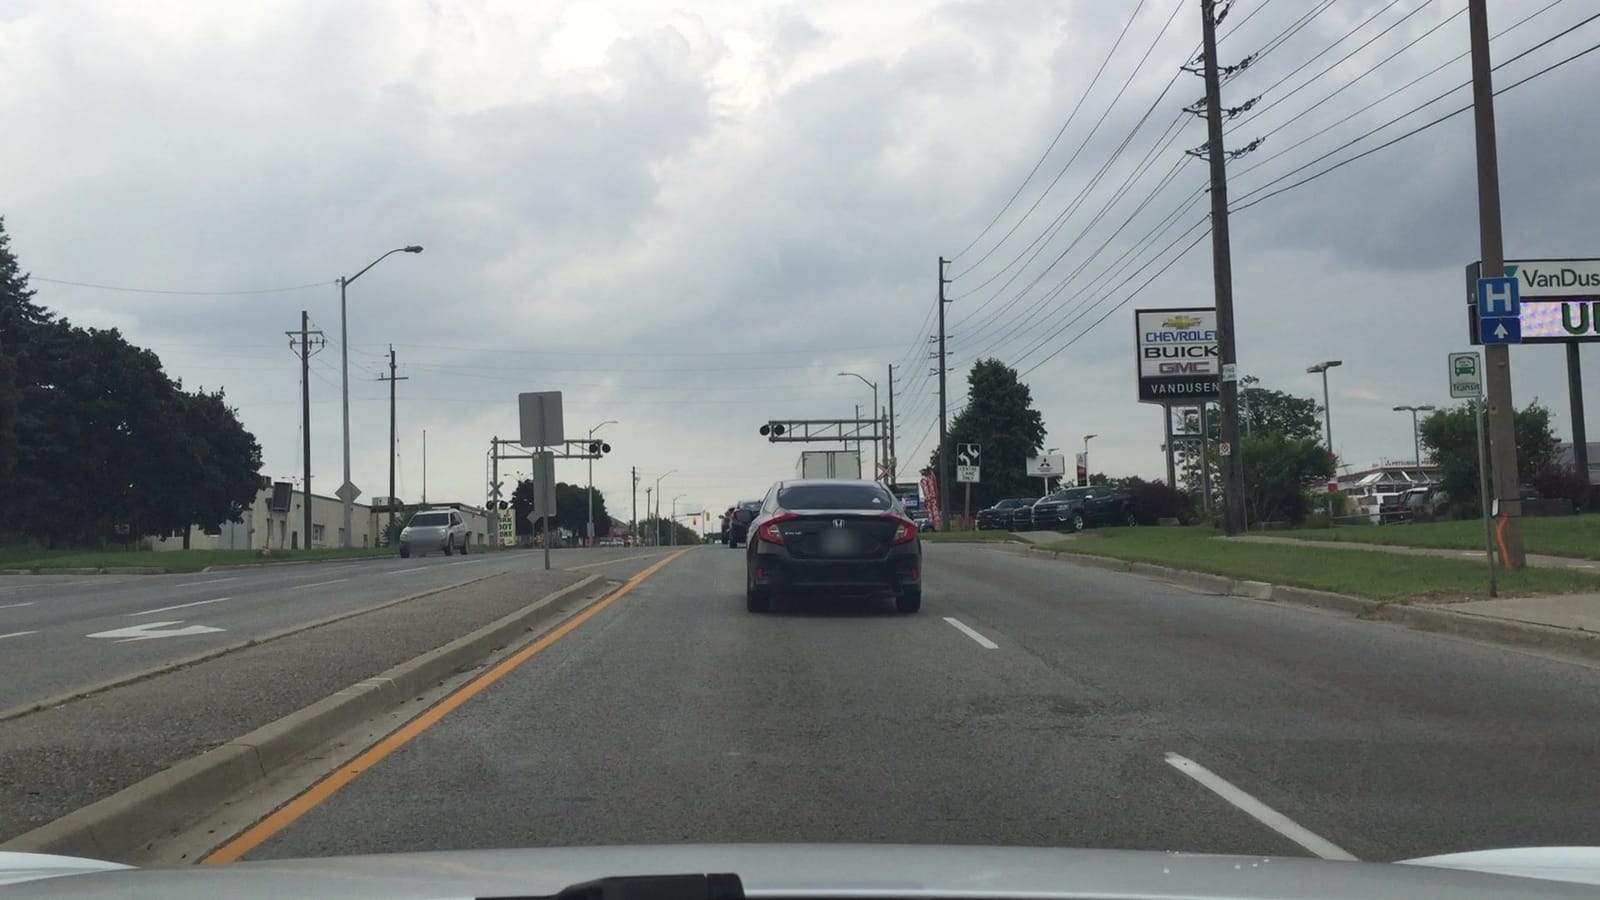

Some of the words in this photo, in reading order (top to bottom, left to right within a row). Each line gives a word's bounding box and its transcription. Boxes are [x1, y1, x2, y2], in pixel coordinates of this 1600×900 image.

[1486, 282, 1512, 312] H
[1561, 302, 1600, 335] U
[1144, 346, 1218, 358] BUICK
[1159, 362, 1210, 373] GMC
[1151, 383, 1219, 394] VANDUSEN
